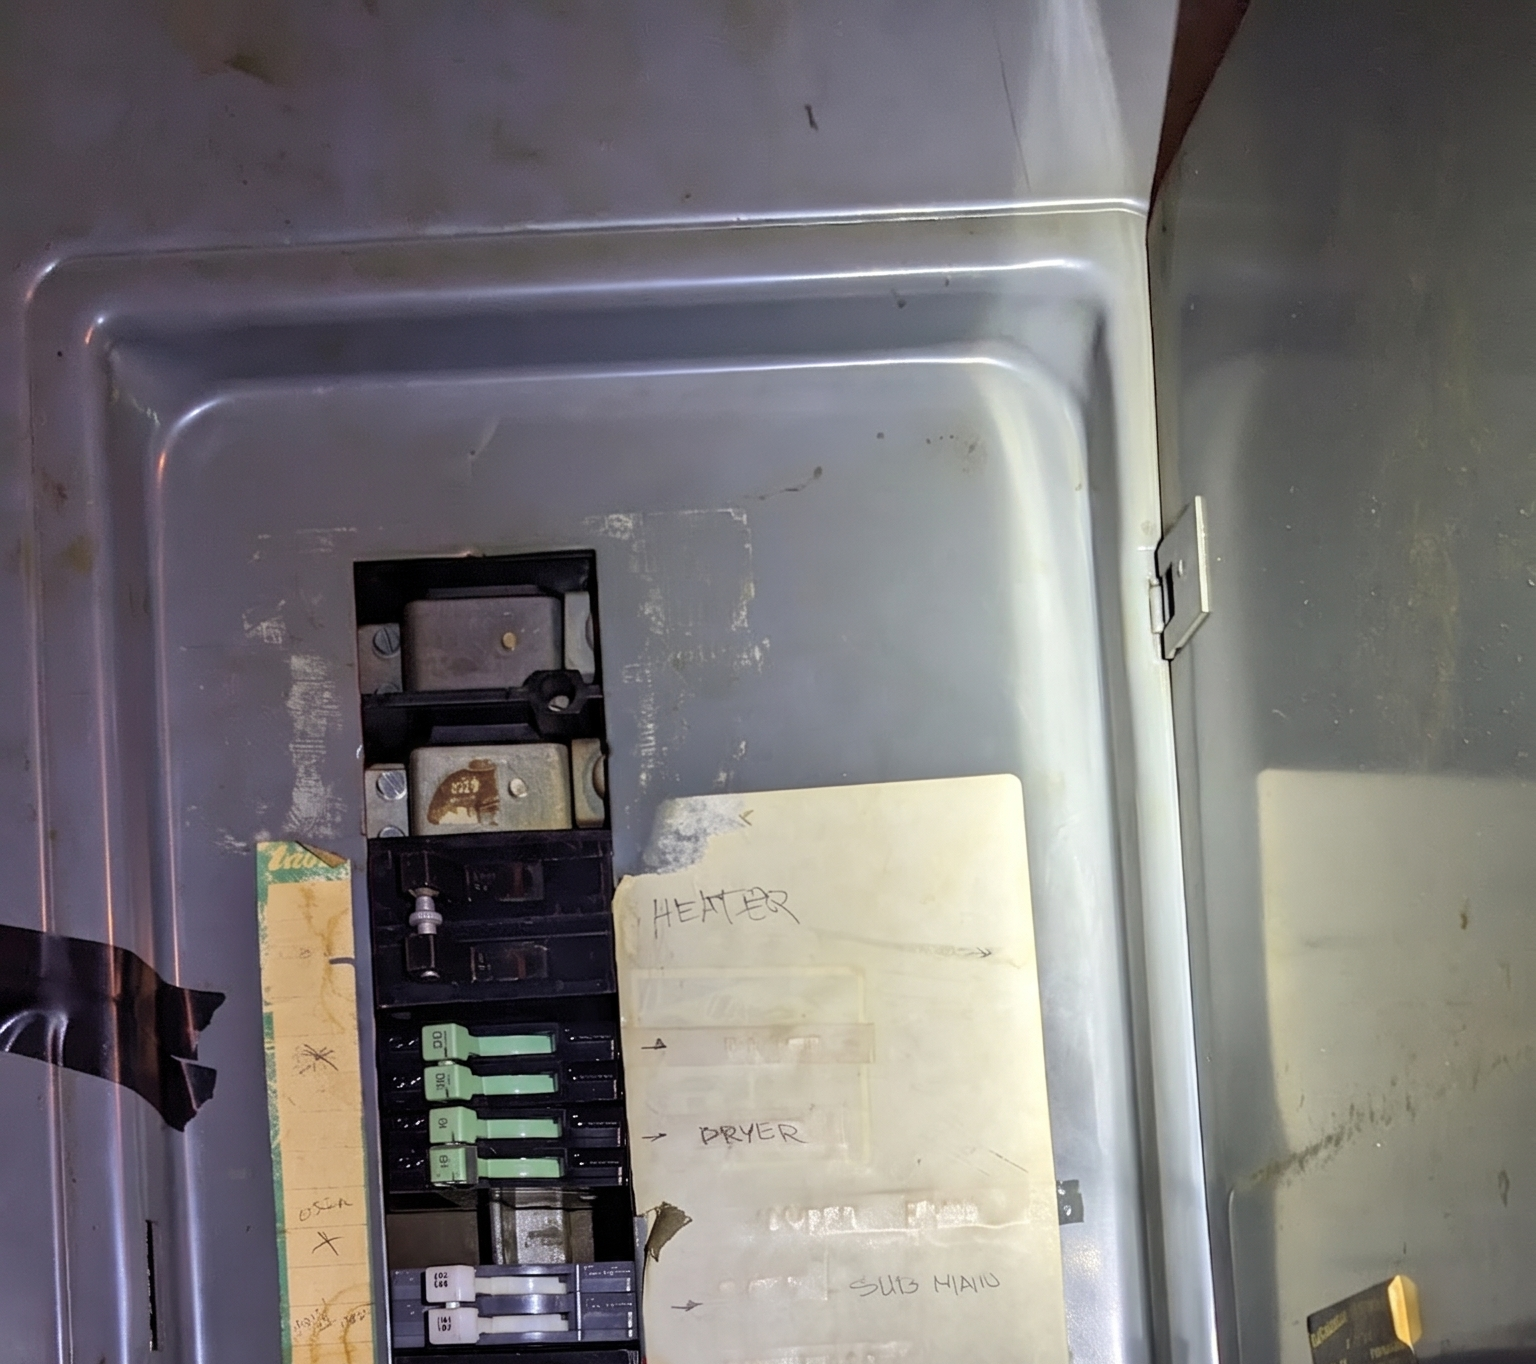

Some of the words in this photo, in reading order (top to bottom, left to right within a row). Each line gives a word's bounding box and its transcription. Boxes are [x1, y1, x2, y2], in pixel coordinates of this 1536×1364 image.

[653, 885, 801, 940] HEATER
[698, 1121, 810, 1146] DRYER
[849, 1274, 920, 1298] SUB
